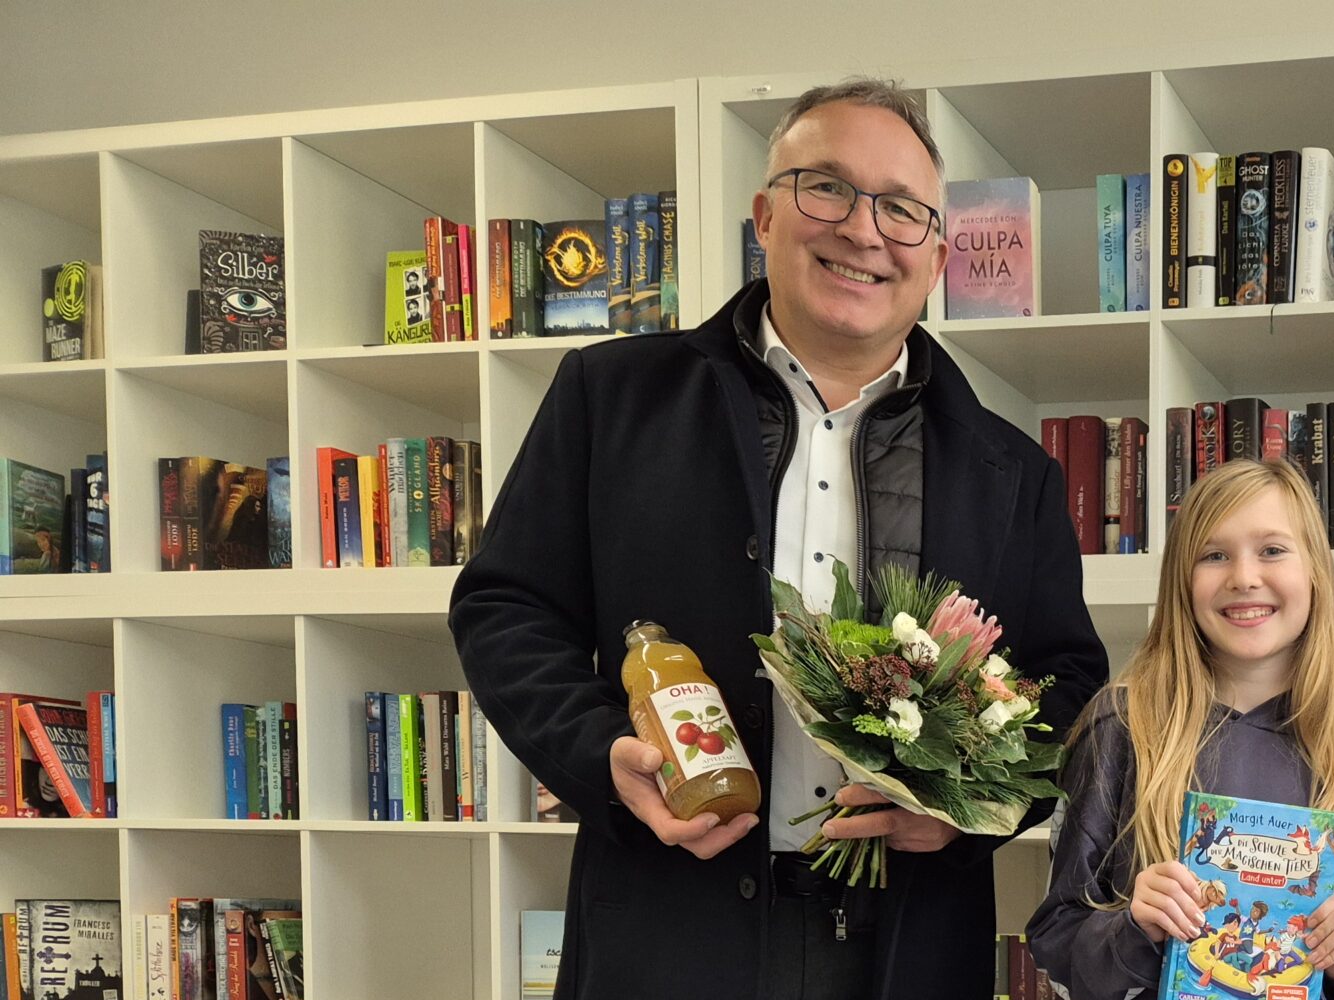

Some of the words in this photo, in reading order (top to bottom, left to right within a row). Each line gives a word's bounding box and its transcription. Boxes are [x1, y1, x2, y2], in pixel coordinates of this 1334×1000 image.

[1238, 164, 1270, 177] GHOST
[1274, 159, 1286, 208] RECKLESS
[1304, 155, 1317, 215] sternenfeuer
[1103, 205, 1113, 229] TUYA
[1134, 184, 1143, 228] NUESTRA
[1169, 180, 1180, 256] BIENENKÖNIGIN
[636, 220, 648, 240] Welt
[662, 211, 674, 241] CHASE
[1281, 223, 1290, 253] FUNKE
[954, 230, 1024, 252] CULPA
[1104, 232, 1113, 262] CULPA
[1135, 231, 1144, 262] CULPA
[1273, 224, 1281, 267] CORNELIA
[217, 251, 280, 281] Silber
[663, 245, 675, 283] MAGNUS
[968, 254, 1012, 279] MÍA
[557, 290, 607, 300] BESTIMMUNG
[1312, 419, 1324, 464] Krabat
[90, 484, 98, 495] 6
[413, 455, 424, 513] SKOGLAND
[429, 447, 441, 505] Alhambra
[1124, 475, 1132, 489] Lilly
[670, 684, 710, 698] OHA!
[1229, 812, 1264, 827] Margit
[1268, 815, 1293, 830] Auer
[1222, 846, 1281, 872] MAGISCHEN
[1283, 857, 1313, 875] TIERE
[1237, 838, 1248, 847] DIE
[1249, 838, 1287, 856] SCHULE
[1241, 874, 1260, 883] Land
[1262, 876, 1286, 886] unter!
[73, 919, 111, 930] FRANCESC
[78, 930, 115, 941] MIRALLES
